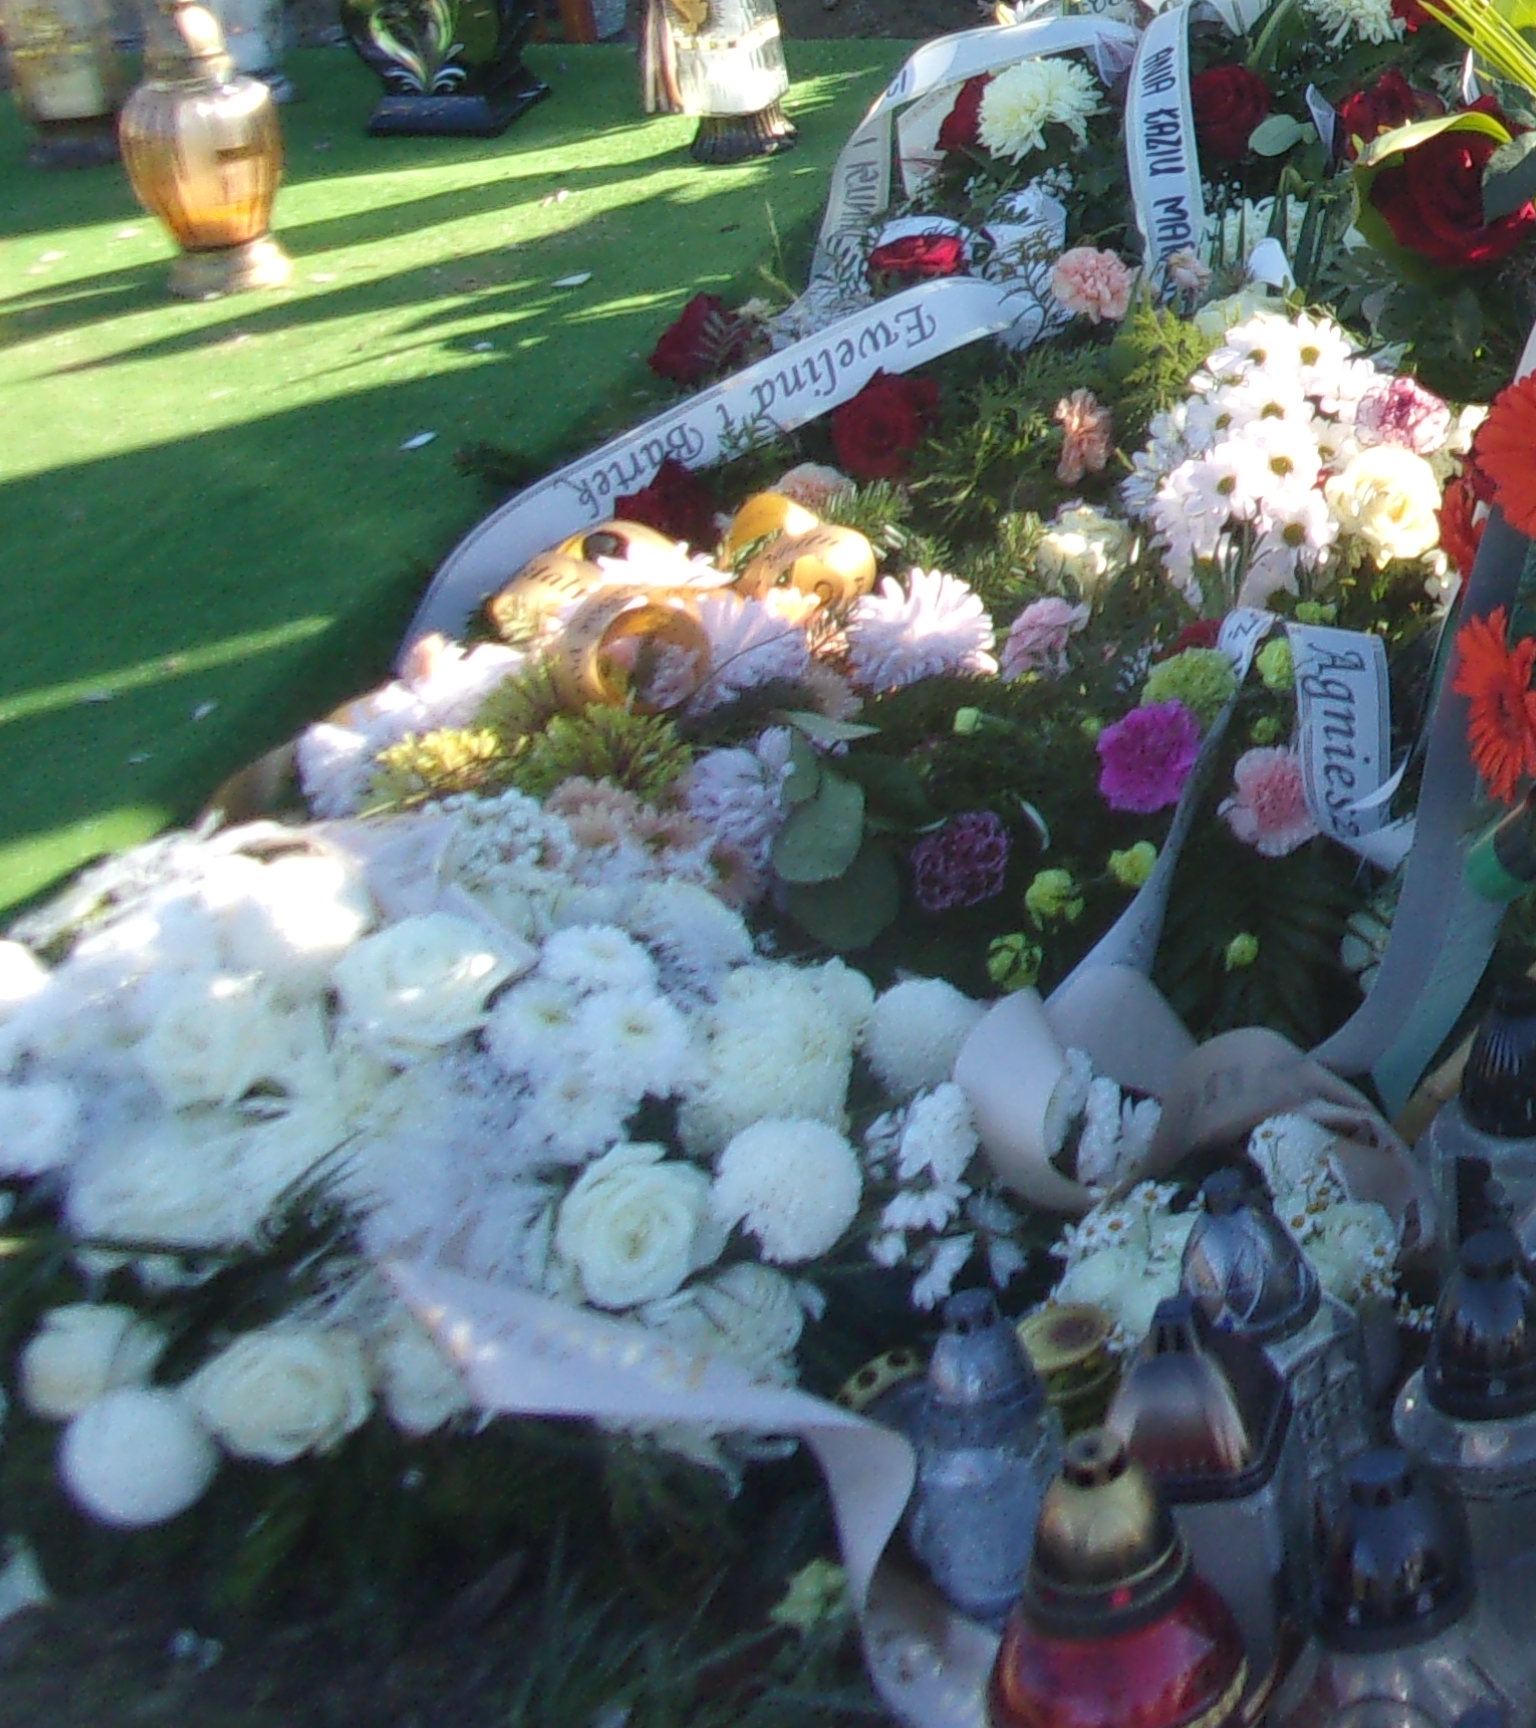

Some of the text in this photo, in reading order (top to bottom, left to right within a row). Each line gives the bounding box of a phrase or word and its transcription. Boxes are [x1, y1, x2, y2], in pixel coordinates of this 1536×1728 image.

[1140, 46, 1176, 99] ANIA
[1143, 106, 1187, 178] KAZIU
[751, 303, 938, 418] Ewelina
[552, 421, 706, 521] Bartek
